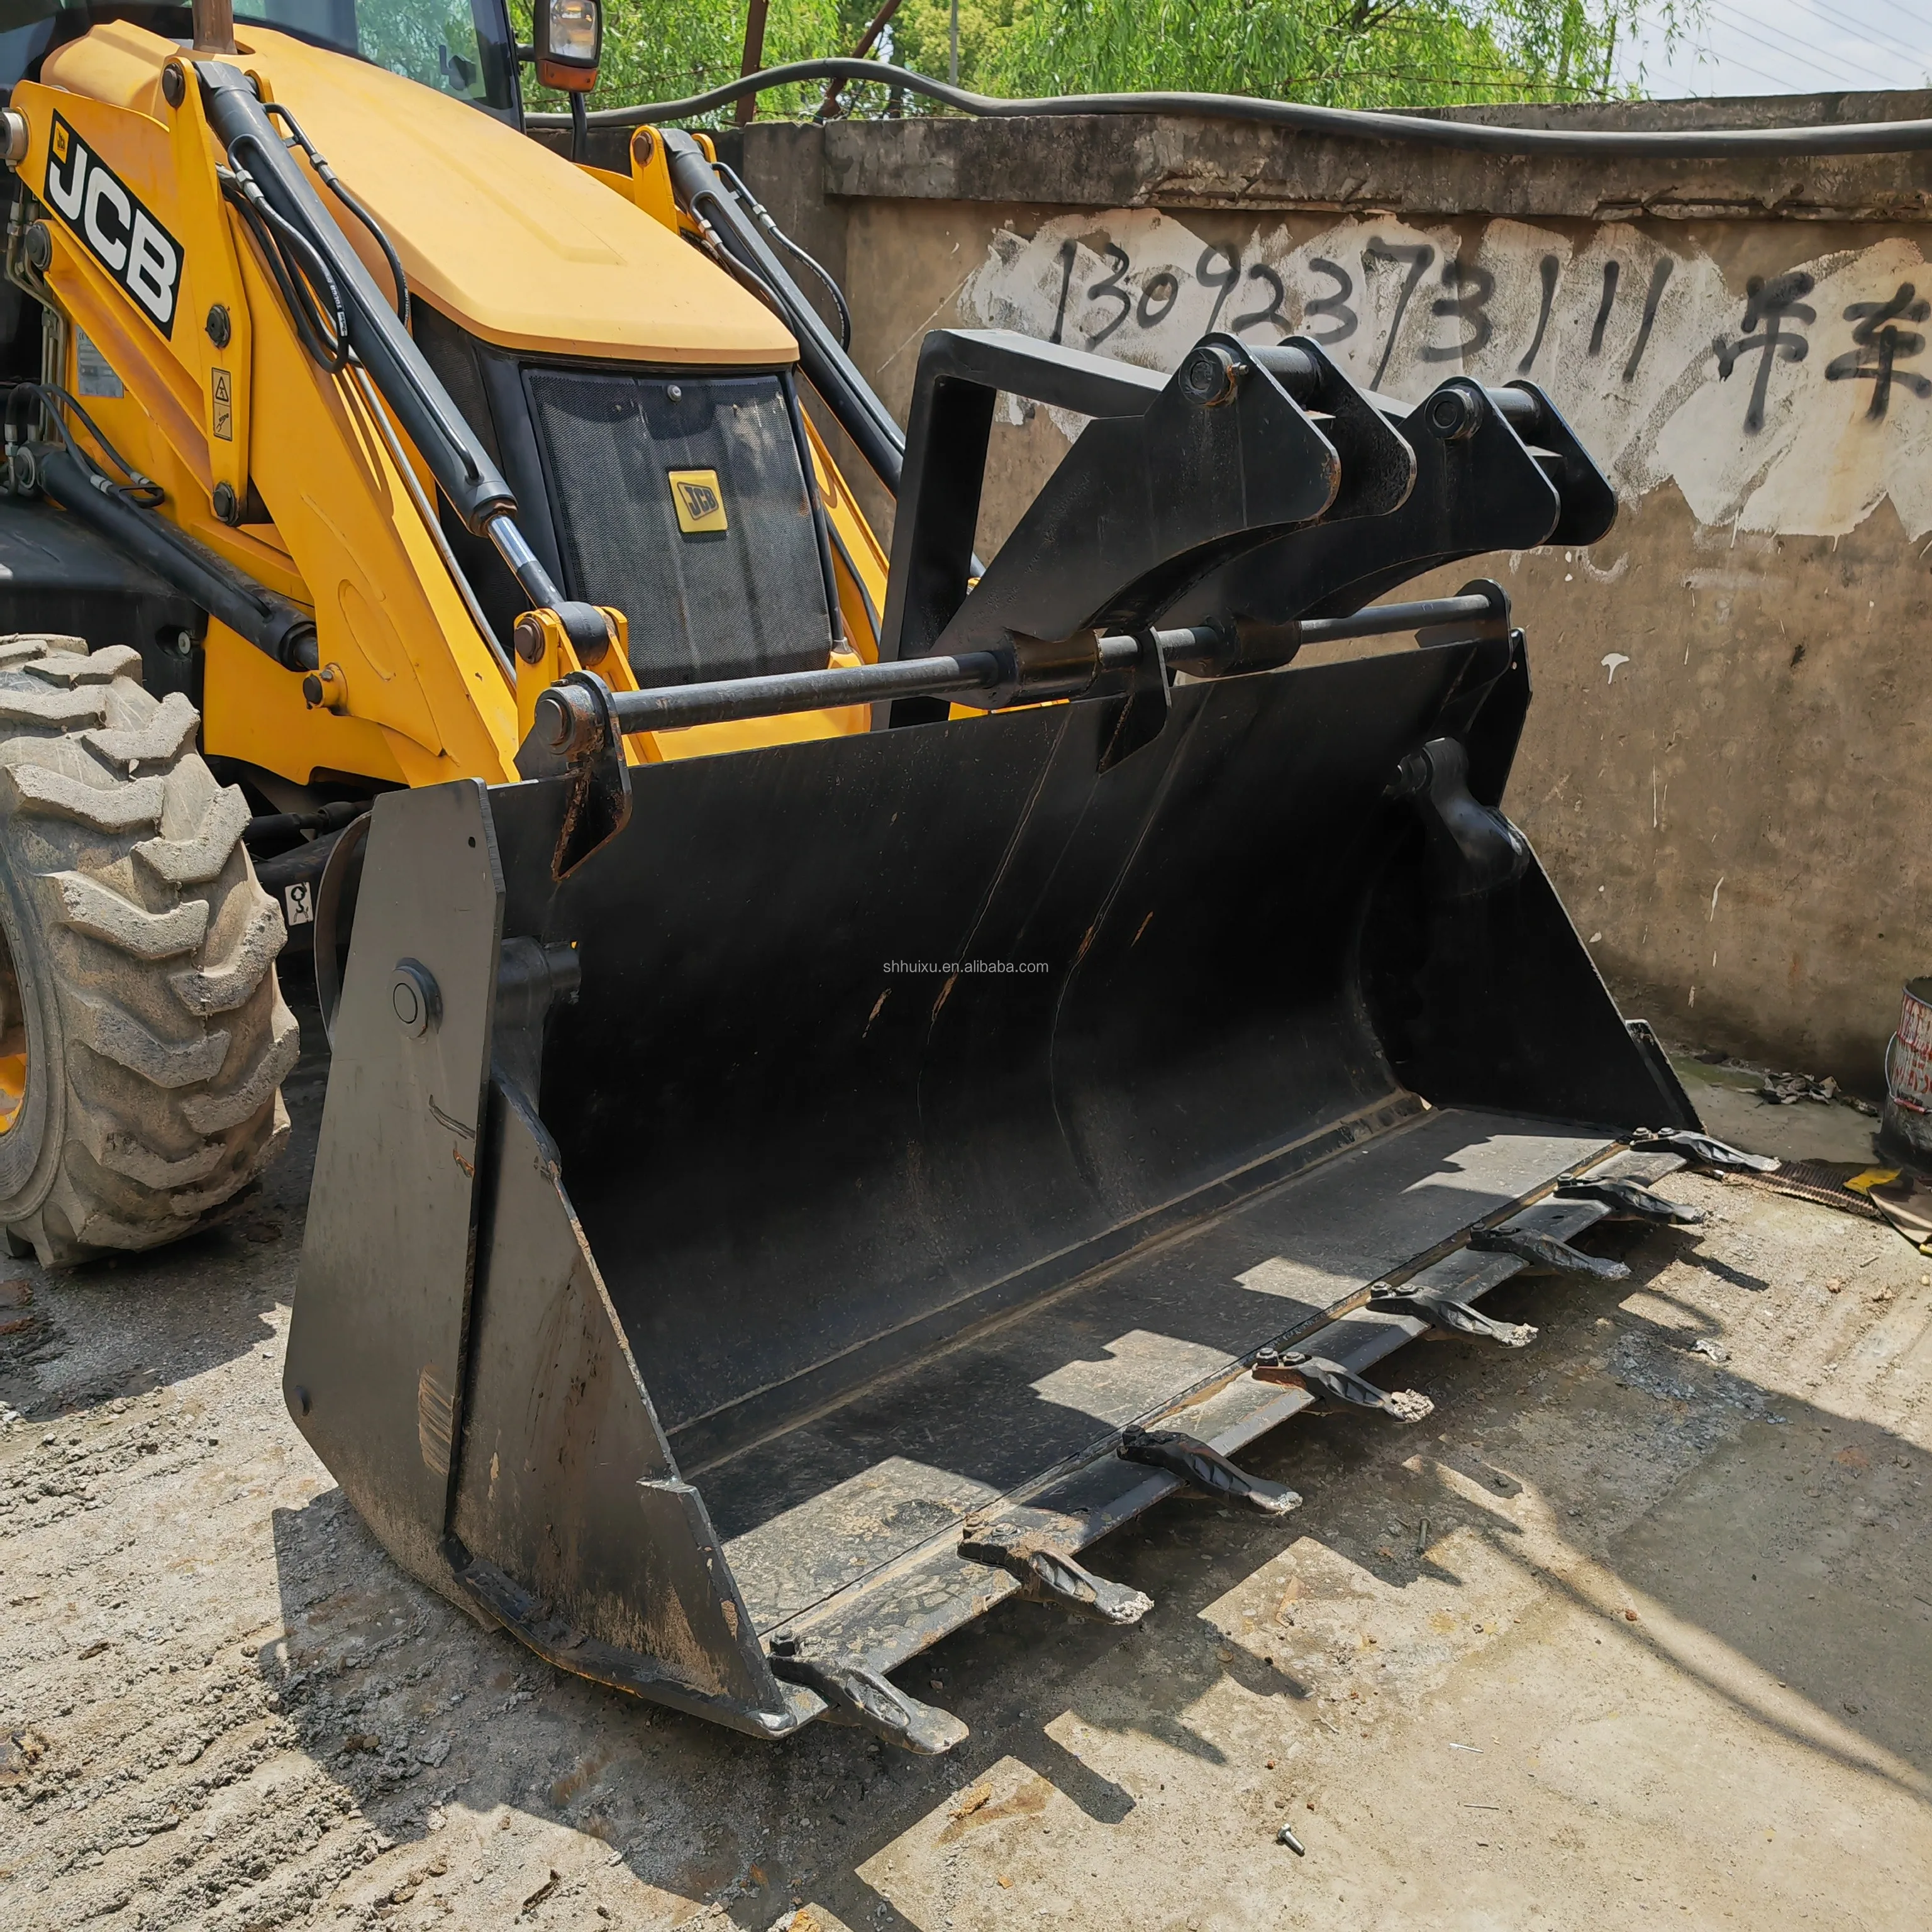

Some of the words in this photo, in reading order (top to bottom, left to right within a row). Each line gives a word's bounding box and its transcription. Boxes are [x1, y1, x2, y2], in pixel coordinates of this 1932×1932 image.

[49, 143, 177, 323] JCB
[1049, 235, 1674, 392] 13092373111
[684, 486, 716, 516] JCB
